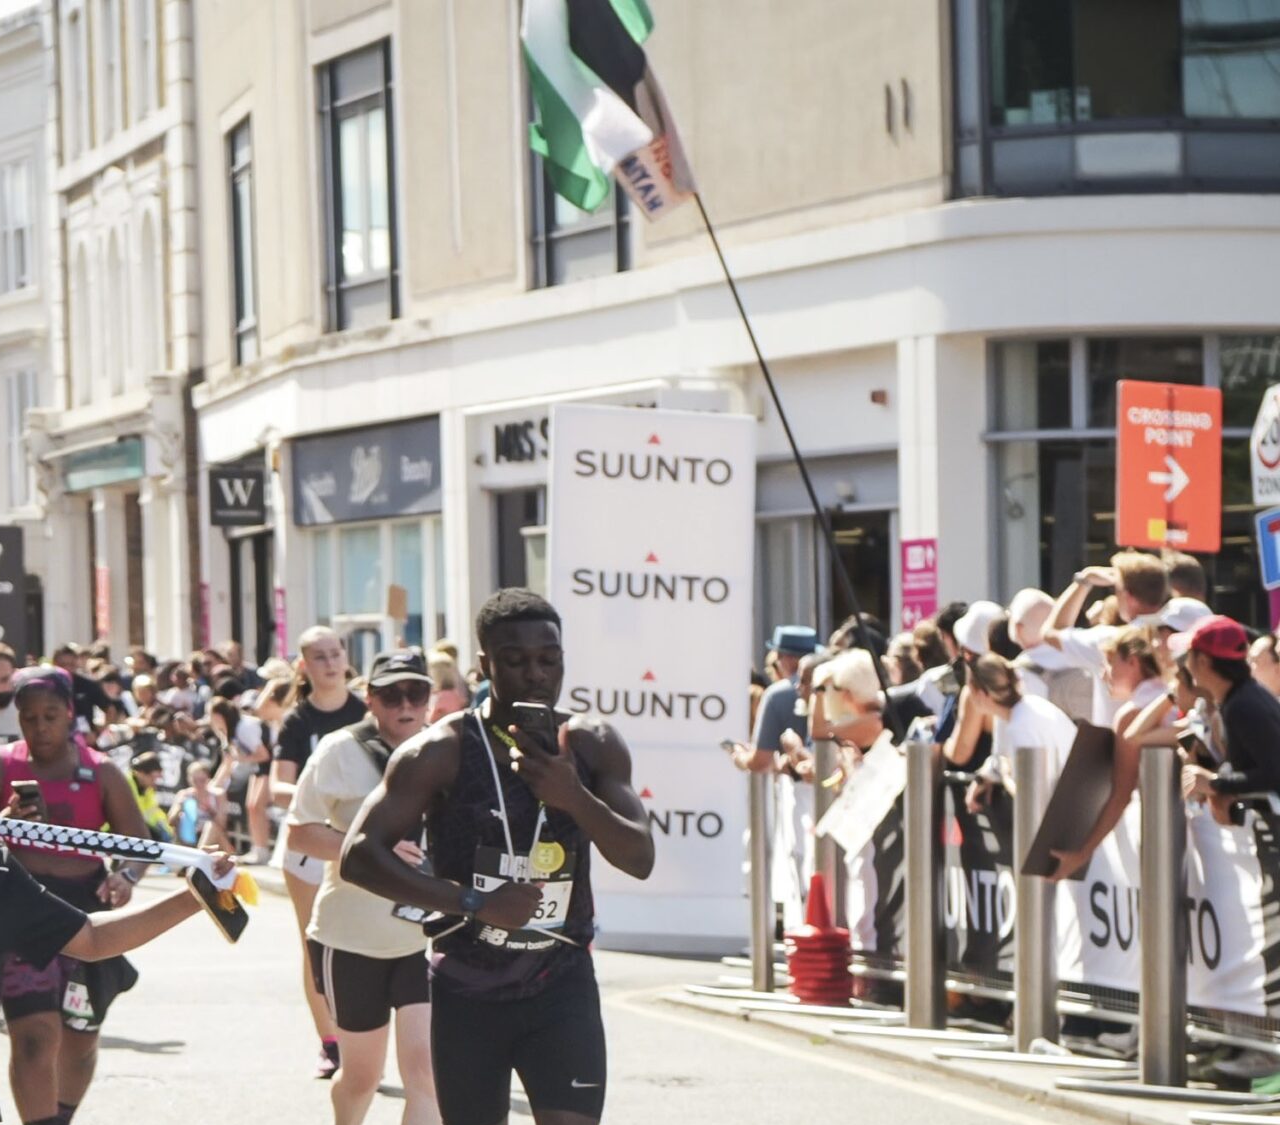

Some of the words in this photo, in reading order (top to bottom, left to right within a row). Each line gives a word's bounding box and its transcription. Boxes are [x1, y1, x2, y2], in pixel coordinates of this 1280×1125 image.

[1127, 407, 1213, 430] CROSSING
[1144, 427, 1195, 448] POINT
[574, 449, 733, 486] SUUNTO
[218, 478, 256, 506] W
[572, 569, 730, 604] SUUNTO
[569, 687, 726, 721] SUUNTO
[648, 809, 724, 839] NTO
[943, 866, 1017, 941] UNTO
[1089, 881, 1222, 971] SUTO
